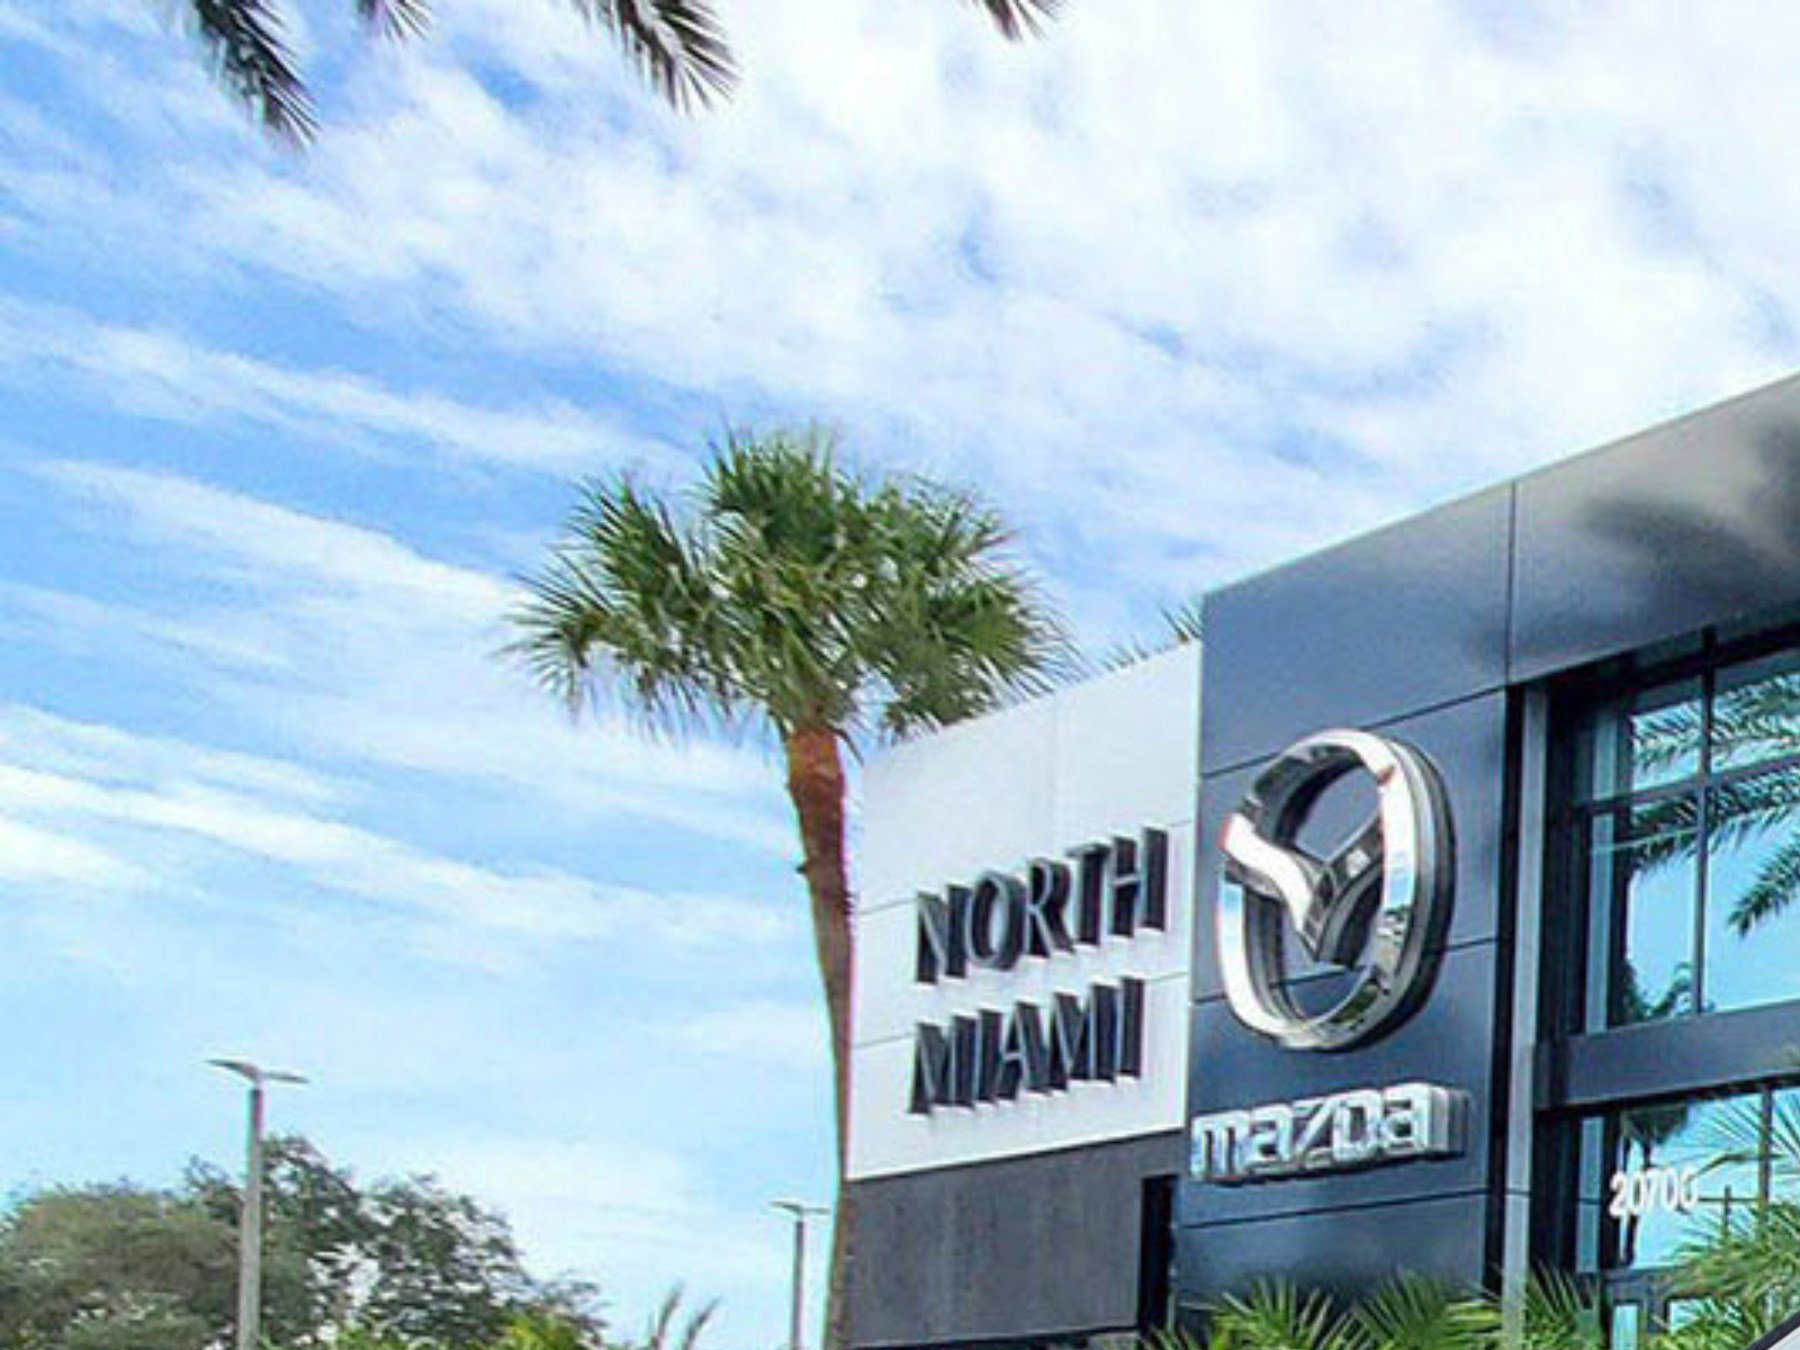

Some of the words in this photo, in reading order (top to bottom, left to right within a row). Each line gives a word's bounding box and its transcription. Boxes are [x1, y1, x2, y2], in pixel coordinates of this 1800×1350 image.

[916, 827, 1168, 985] NORTH
[909, 977, 1145, 1115] MIAMI
[1190, 1081, 1466, 1185] mazda
